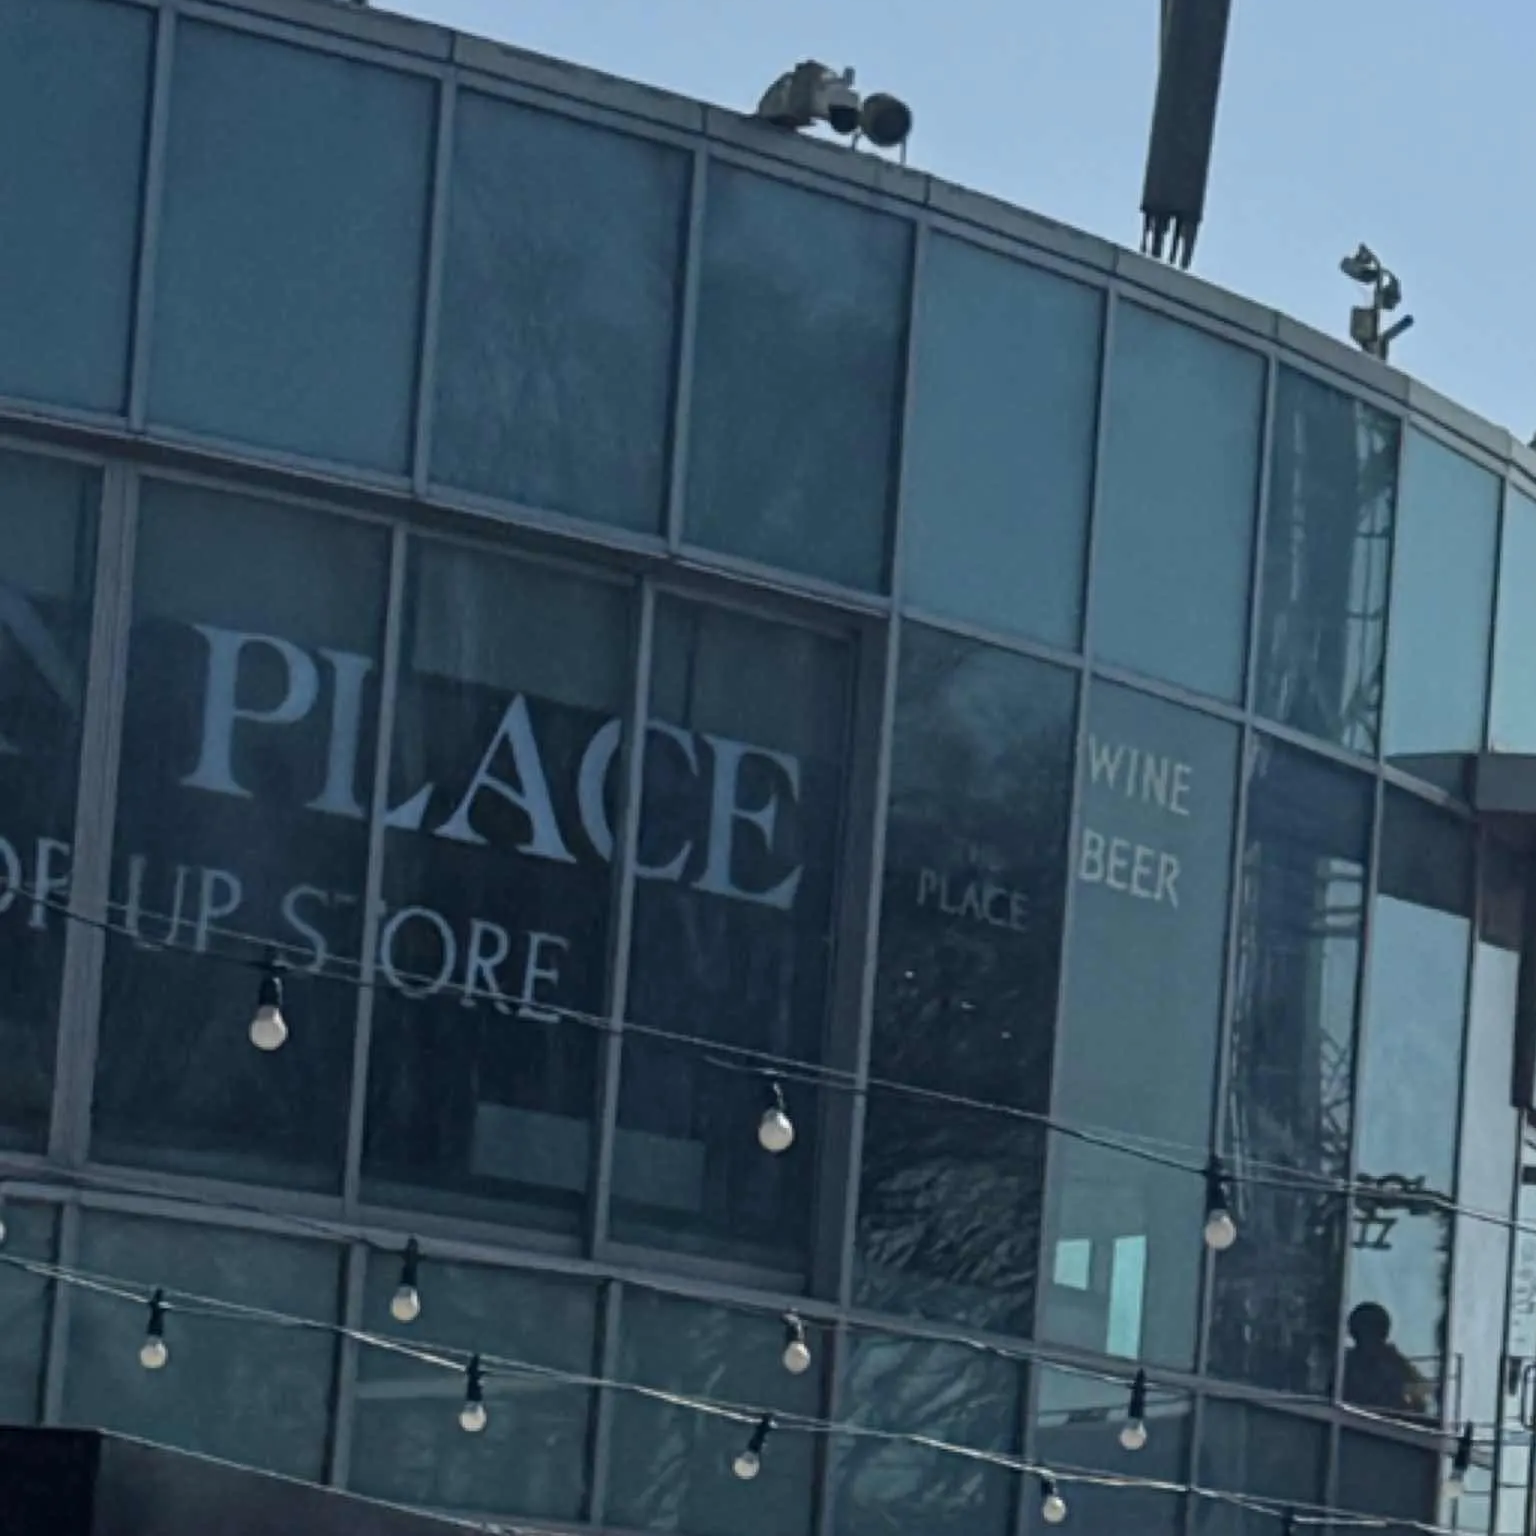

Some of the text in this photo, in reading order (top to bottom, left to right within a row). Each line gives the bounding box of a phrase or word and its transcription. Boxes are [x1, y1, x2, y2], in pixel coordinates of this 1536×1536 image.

[181, 623, 804, 910] PLACE
[1089, 732, 1193, 817] WINE
[124, 853, 242, 954] UP
[916, 865, 1031, 935] PLACE
[1078, 828, 1182, 911] BEER
